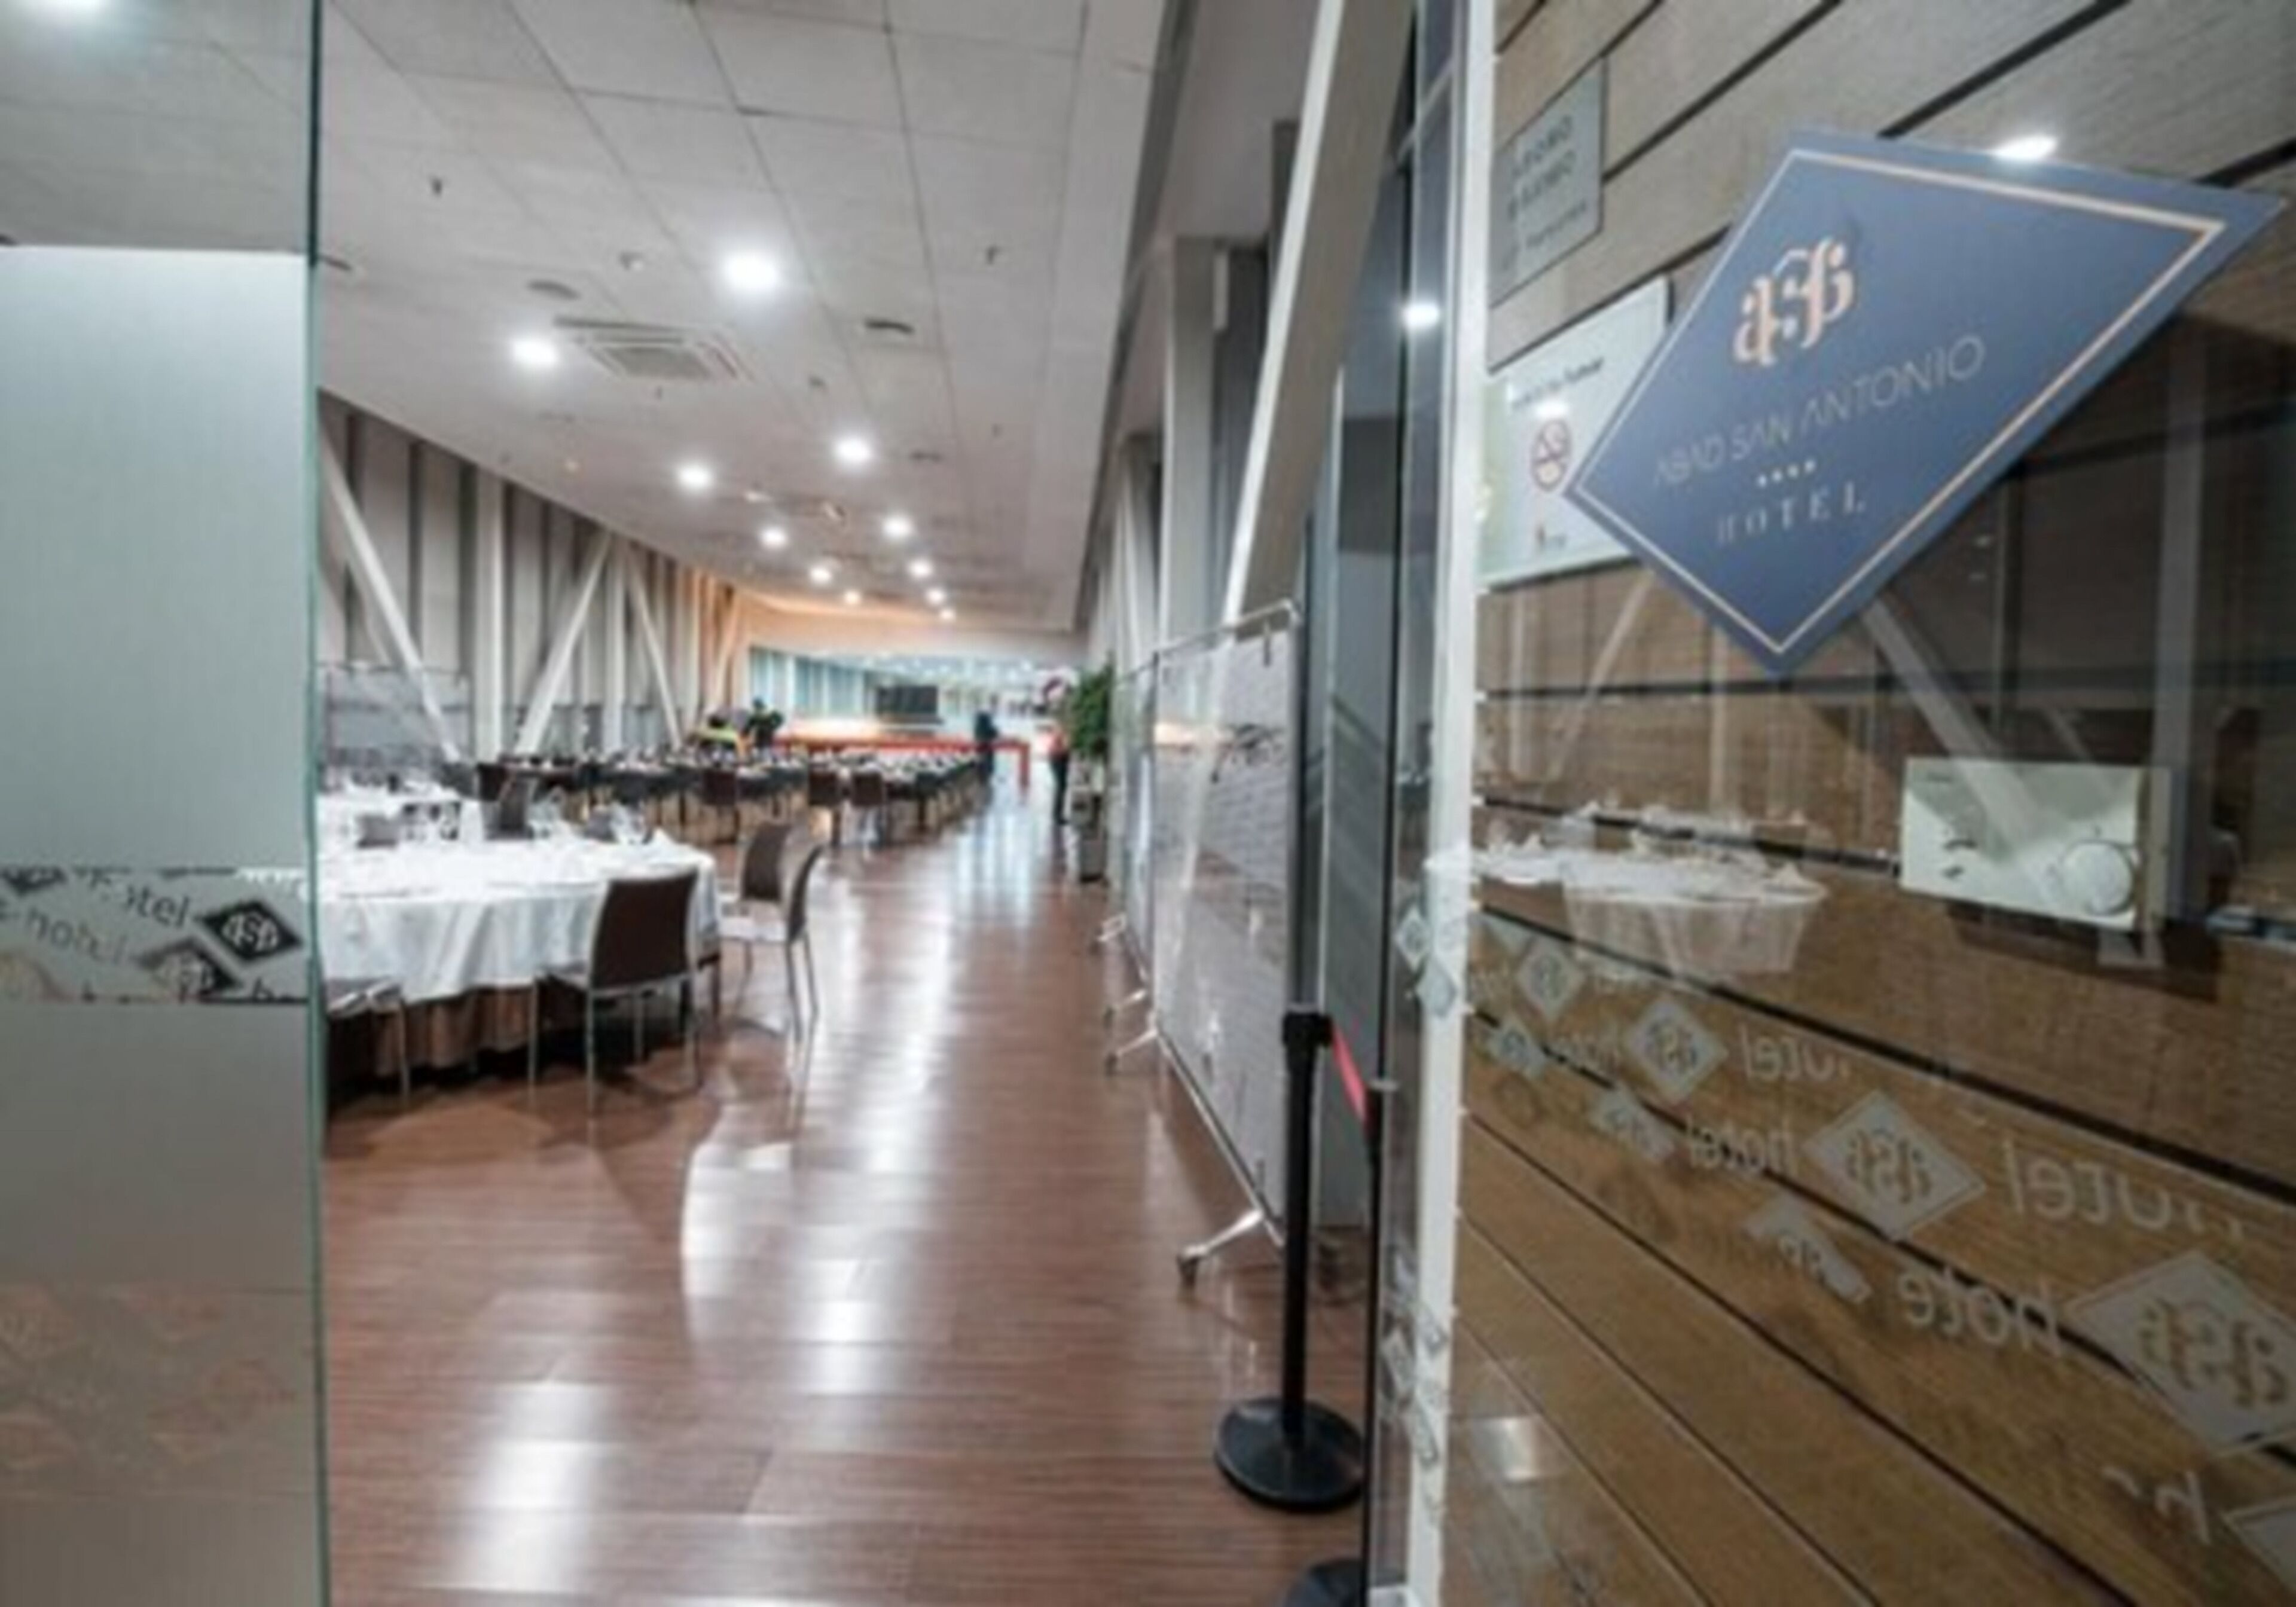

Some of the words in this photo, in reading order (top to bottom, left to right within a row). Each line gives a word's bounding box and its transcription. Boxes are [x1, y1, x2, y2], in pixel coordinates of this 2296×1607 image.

[1654, 432, 1724, 488] ABAD
[1730, 413, 1791, 463] SAN
[1800, 334, 1986, 435] ANTONIO
[1717, 480, 1867, 544] HOTEL
